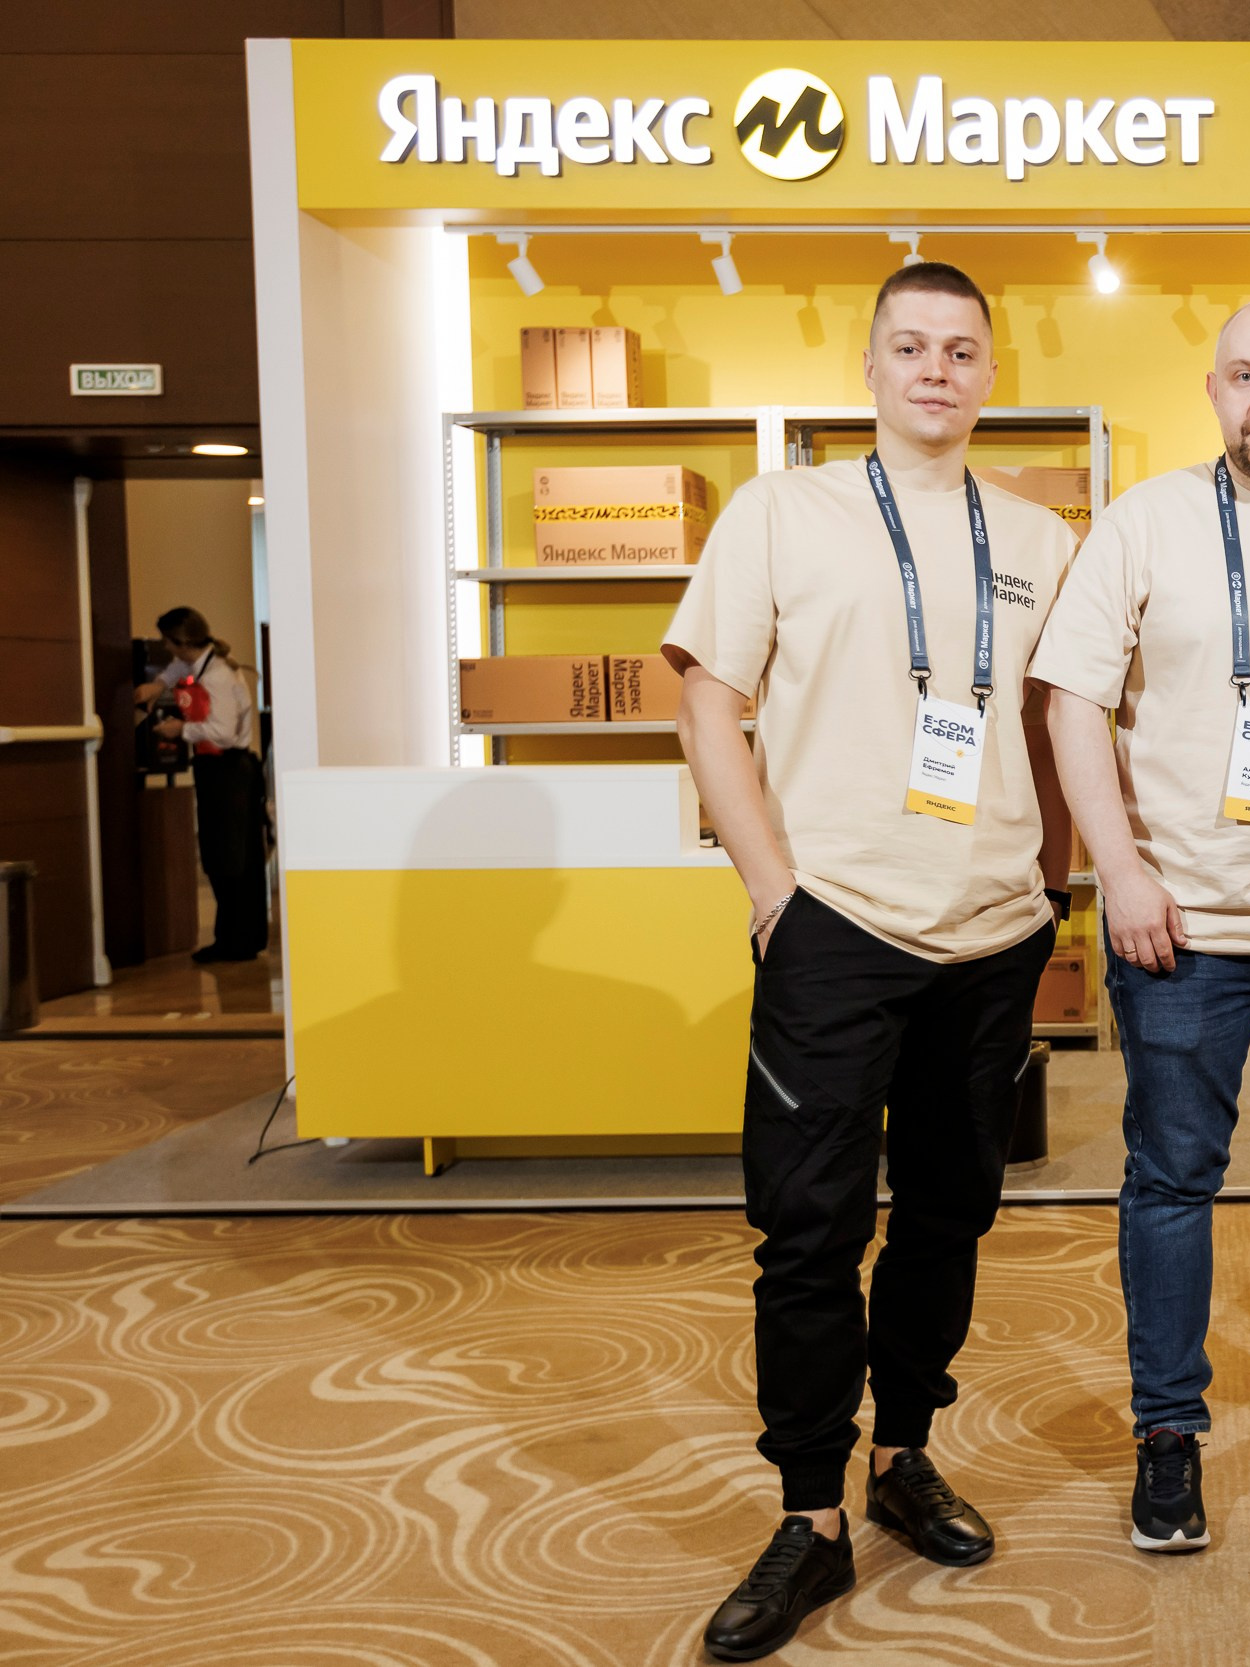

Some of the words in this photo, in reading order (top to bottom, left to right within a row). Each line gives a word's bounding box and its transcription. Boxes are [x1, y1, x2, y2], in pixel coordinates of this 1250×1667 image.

[378, 74, 713, 178] Яндекс
[867, 74, 1217, 181] Маркет
[543, 544, 607, 563] Яндекс
[611, 544, 678, 563] Маркет
[907, 581, 917, 609] Маркет
[1234, 589, 1242, 617] Маркет
[981, 620, 989, 648] Маркет
[570, 662, 584, 718] Яндекс
[586, 661, 600, 718] Маркет
[613, 659, 628, 716] Маркет
[629, 659, 643, 714] Яндекс
[923, 725, 976, 746] СФЕРА
[924, 714, 974, 736] E-COM
[926, 799, 957, 812] ЯНДЕКС
